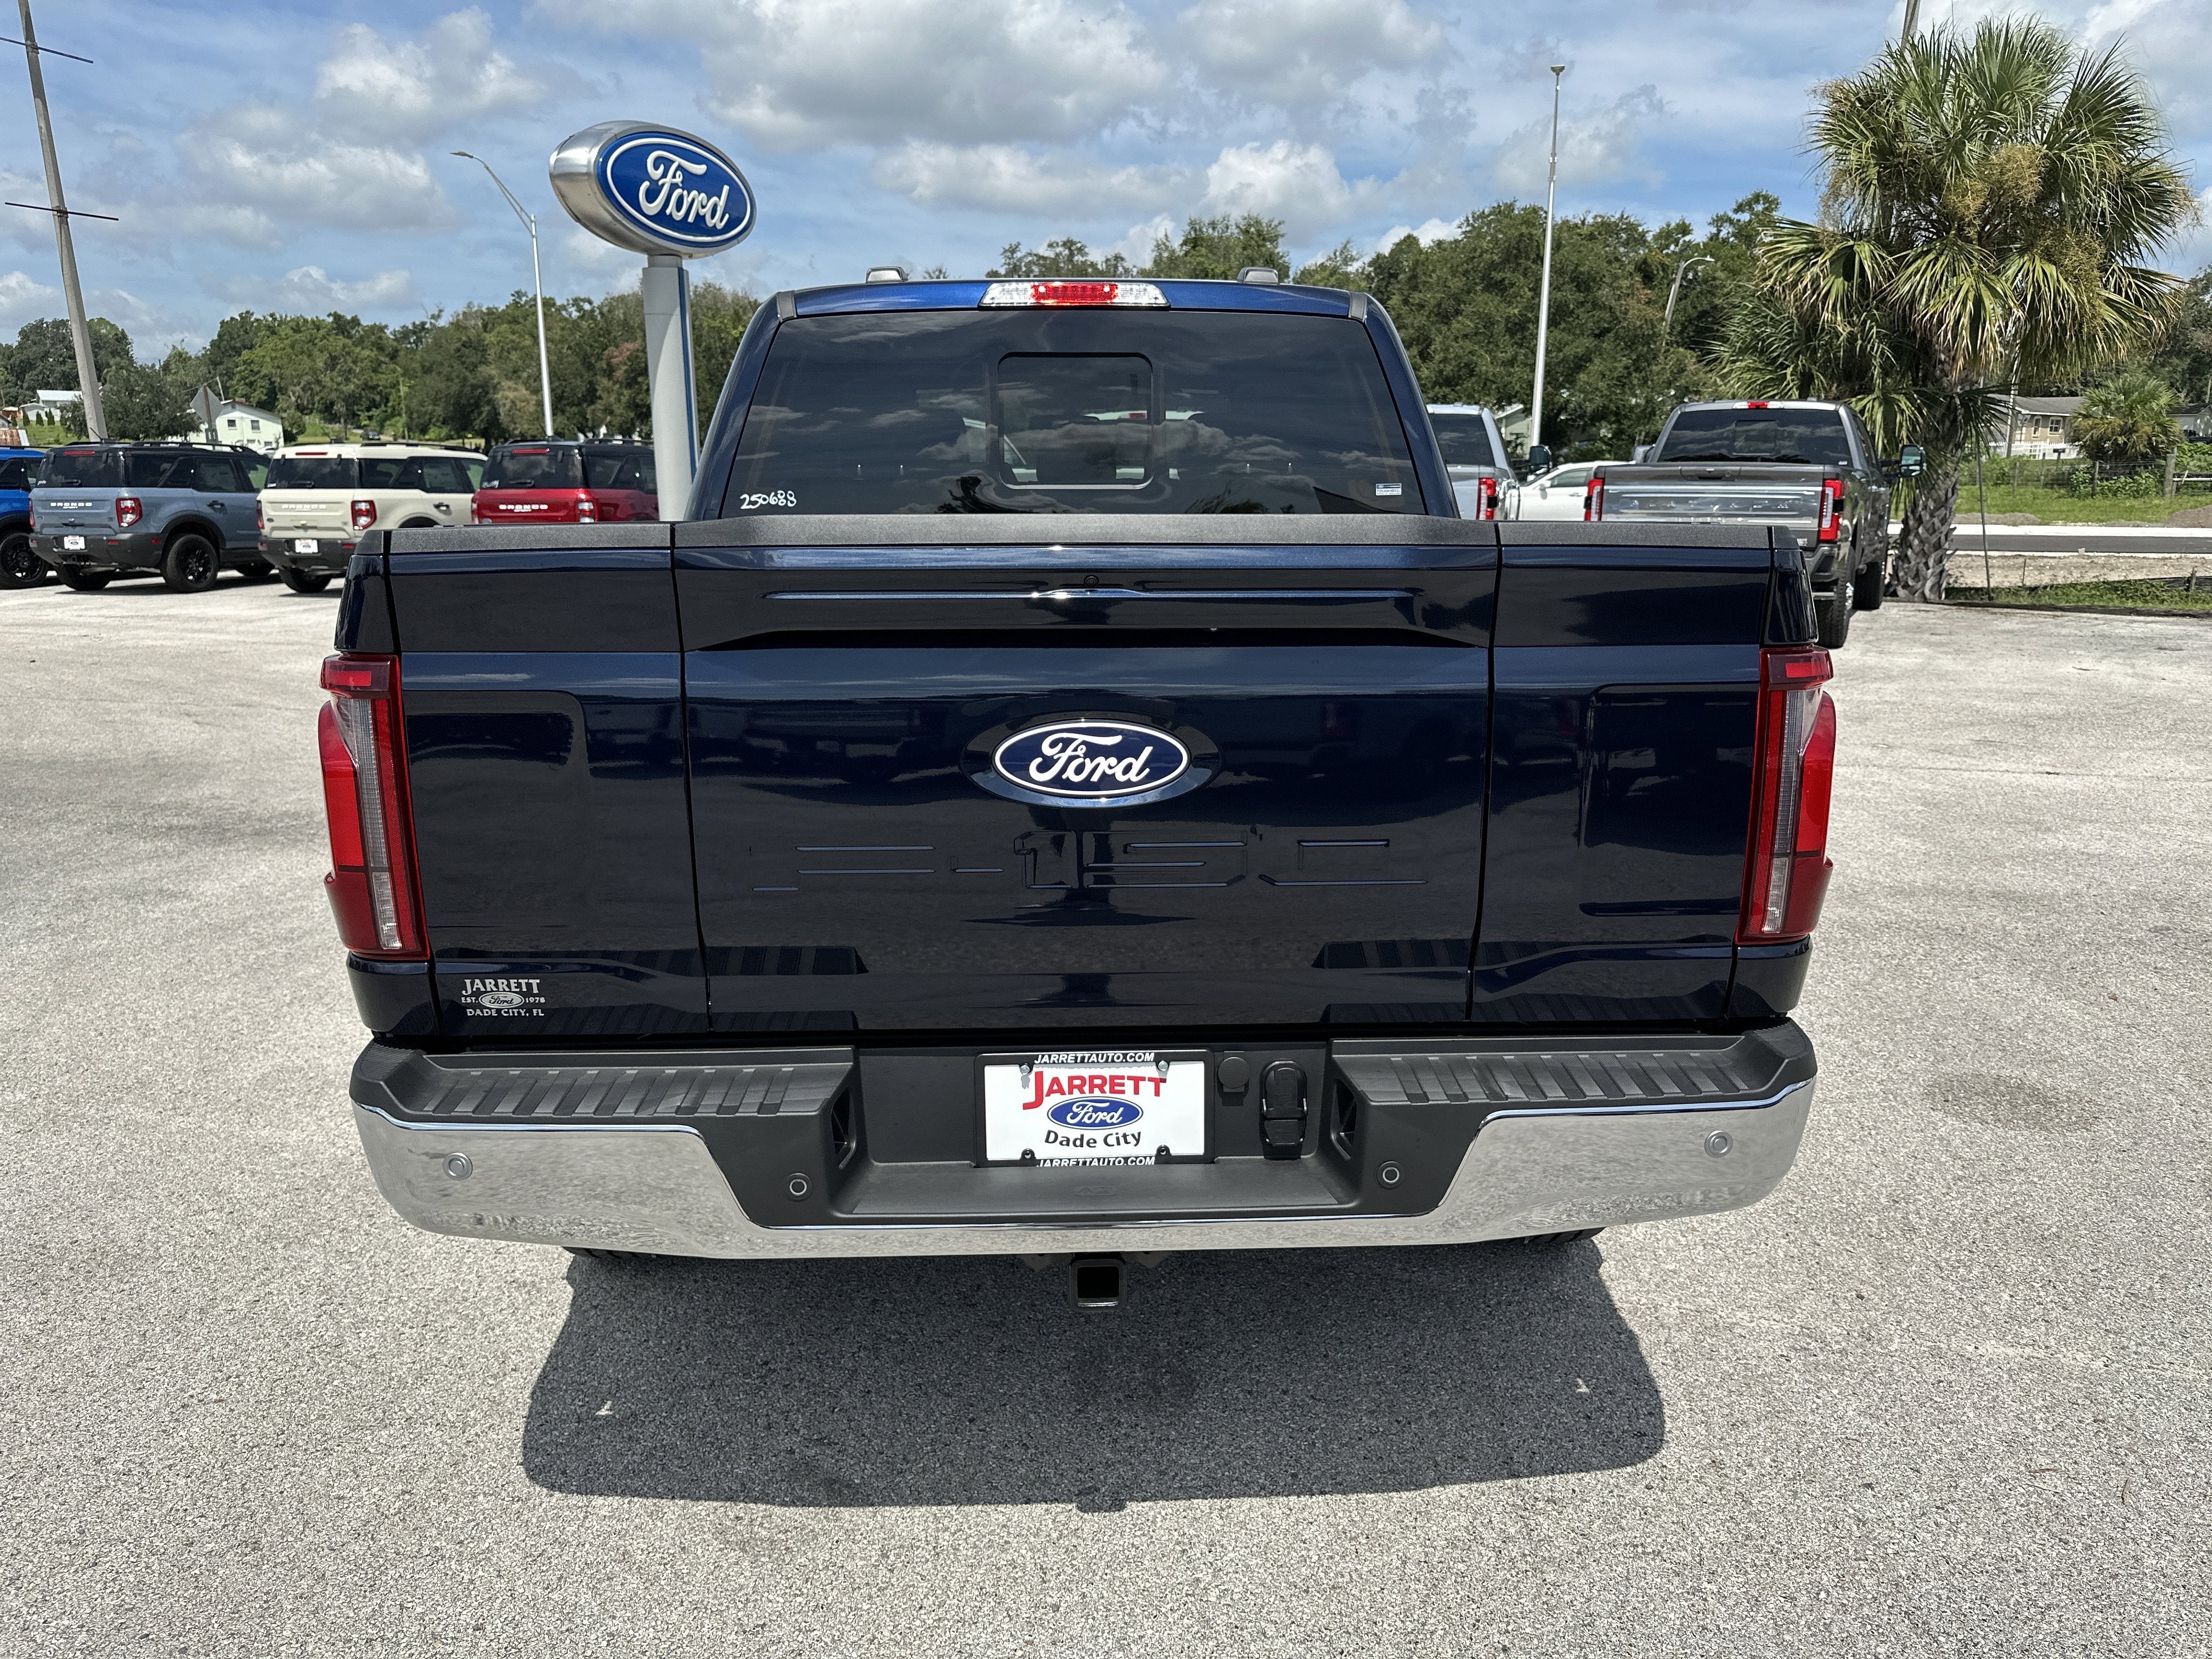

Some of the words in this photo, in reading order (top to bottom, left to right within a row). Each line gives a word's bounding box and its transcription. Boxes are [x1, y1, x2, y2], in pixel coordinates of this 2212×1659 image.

[639, 150, 729, 229] Ford
[740, 490, 797, 509] 250688
[1029, 732, 1153, 782] Ford
[462, 979, 540, 995] JARRETT
[489, 995, 514, 1005] Ford
[1034, 1052, 1155, 1064] JARRETTAUTO.COM
[1023, 1070, 1167, 1110] JARRETT
[1066, 1101, 1124, 1124] Ford
[1045, 1130, 1097, 1148] Dade
[1103, 1131, 1142, 1147] City
